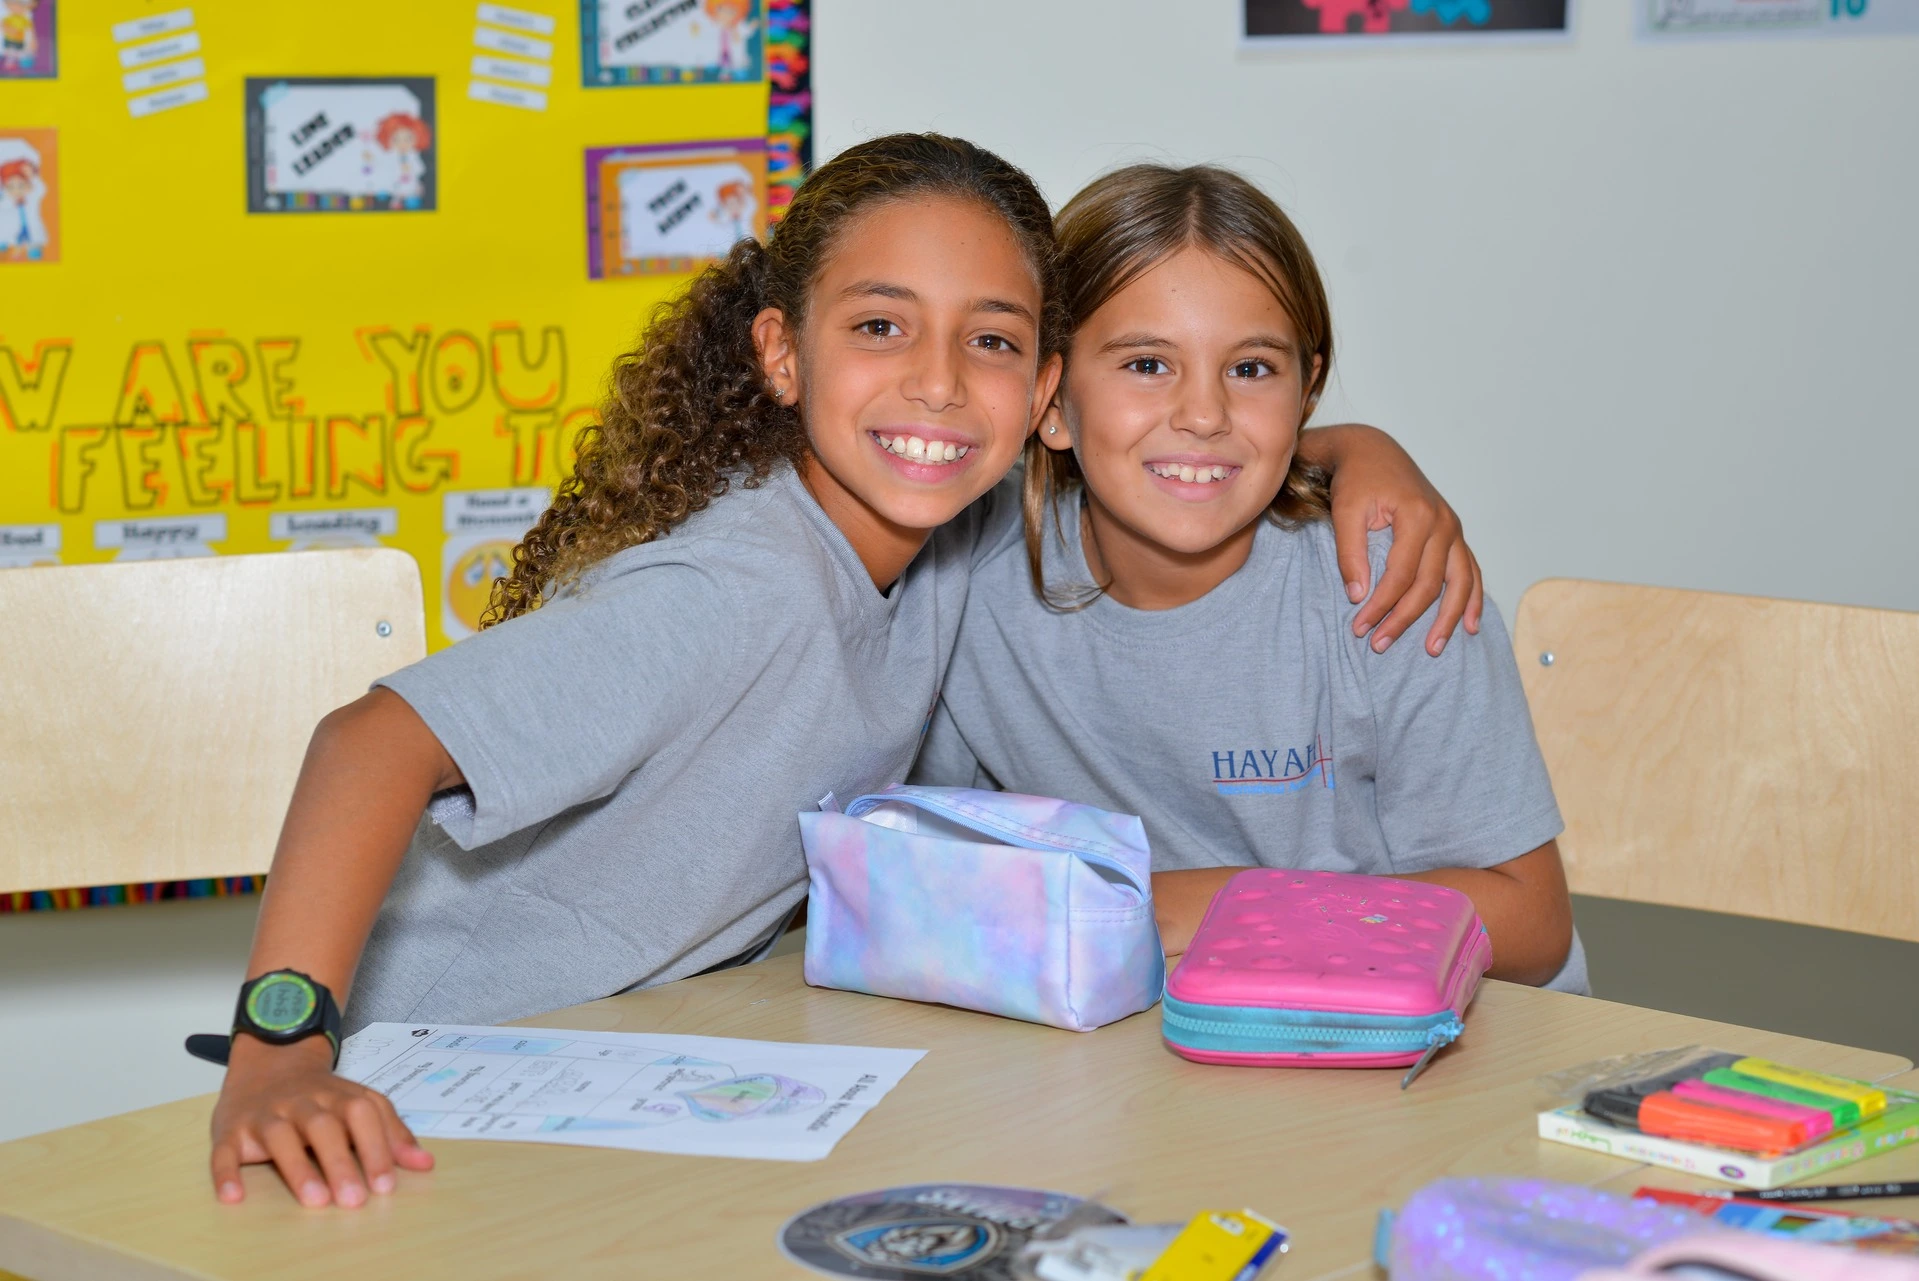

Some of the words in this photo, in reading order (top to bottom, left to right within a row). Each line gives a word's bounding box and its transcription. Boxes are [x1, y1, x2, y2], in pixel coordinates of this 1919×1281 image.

[290, 112, 328, 147] LINE
[292, 124, 355, 177] LEADER
[112, 336, 302, 426] ARE
[366, 324, 568, 418] YOU
[54, 414, 456, 512] FEELING
[122, 524, 198, 545] Happy
